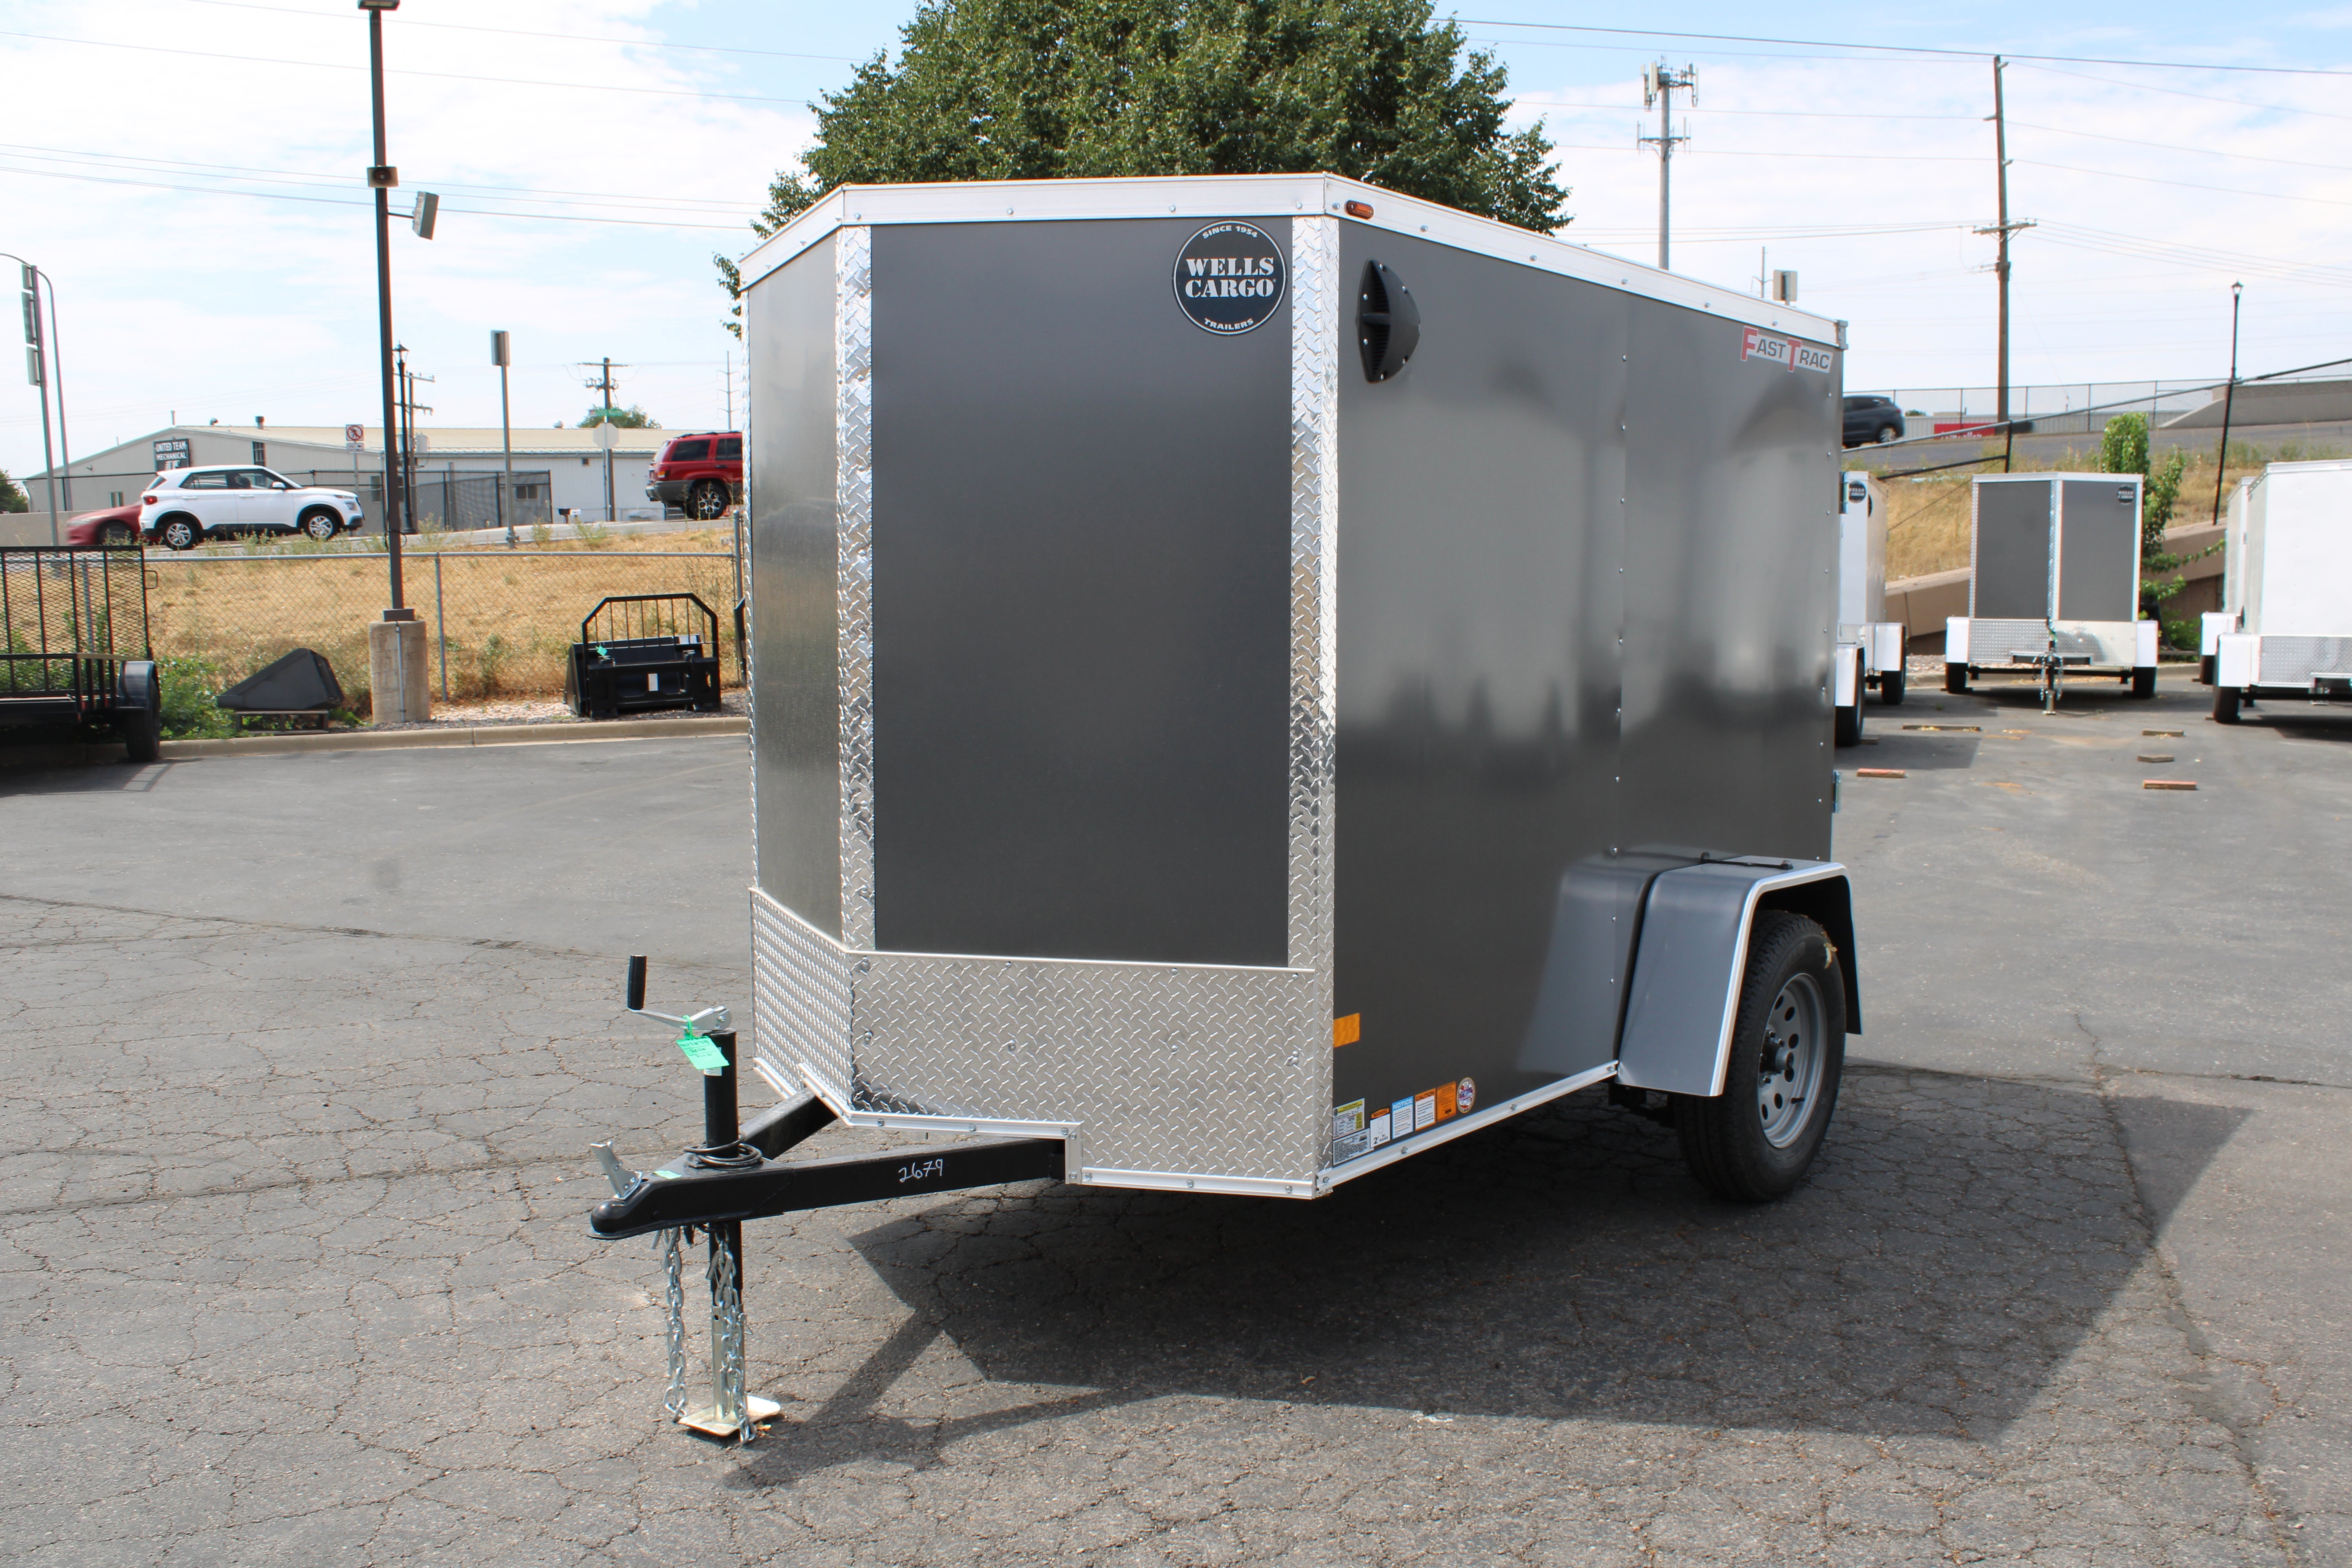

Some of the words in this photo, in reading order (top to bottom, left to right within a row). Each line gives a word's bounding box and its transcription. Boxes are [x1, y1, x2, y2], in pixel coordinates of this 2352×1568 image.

[1203, 225, 1232, 238] SINCE
[1236, 226, 1258, 238] 1954
[1186, 257, 1274, 276] WELLS
[1185, 278, 1274, 298] CARGO
[1204, 318, 1254, 330] TRAILERS
[172, 441, 187, 451] TEAM
[156, 452, 187, 461] MECHANICAL
[1416, 1091, 1434, 1101] CAUTION
[1393, 1098, 1412, 1109] NOTICE
[898, 1158, 943, 1183] 2679
